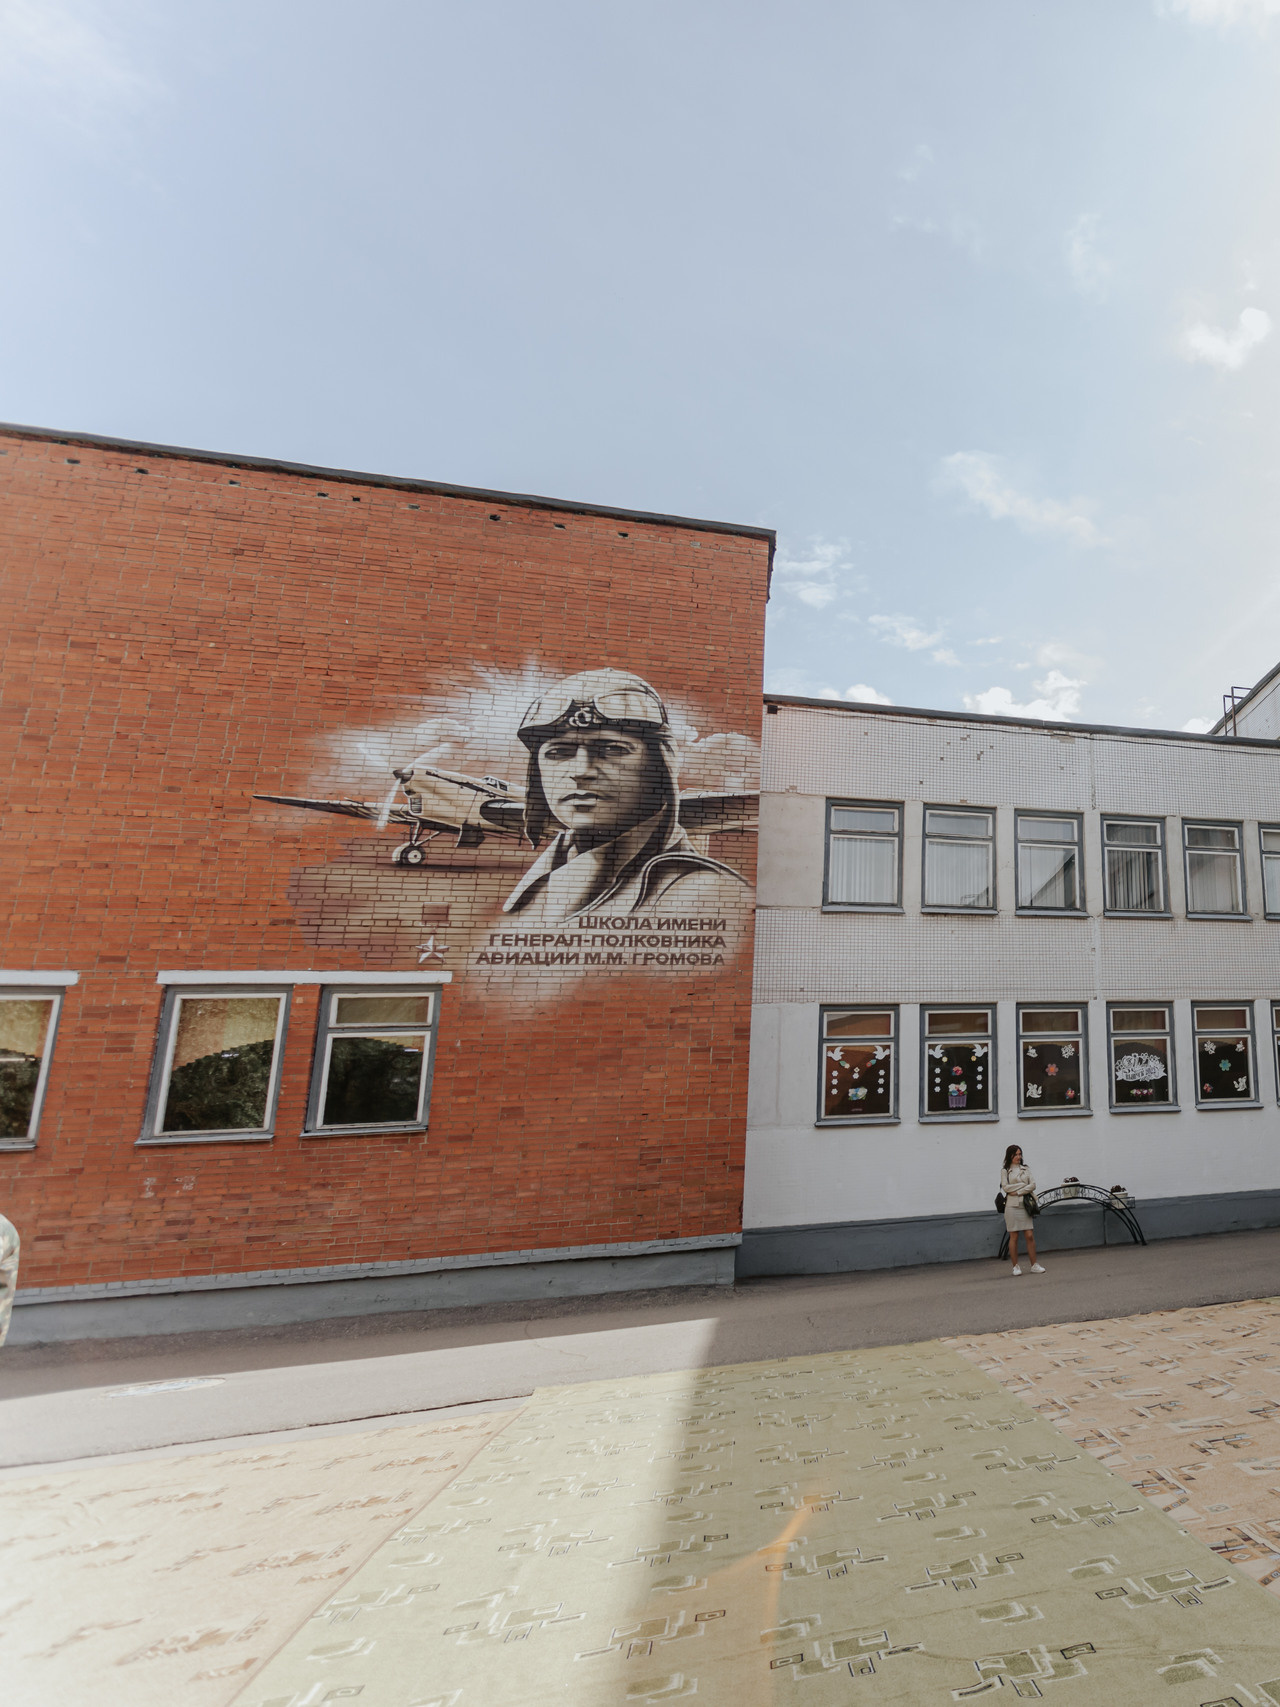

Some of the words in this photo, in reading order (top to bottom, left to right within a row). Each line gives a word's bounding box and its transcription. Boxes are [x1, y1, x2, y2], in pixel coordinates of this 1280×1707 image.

[578, 916, 652, 930] ШКОЛА
[657, 918, 727, 931] ИМЕНИ
[489, 934, 727, 948] ГЕНЕРАЛ-ПОЛКОВНИКА
[475, 952, 580, 966] АВИАЦИИ
[584, 952, 627, 965] М.М.
[632, 953, 725, 966] ГРОМОВА
